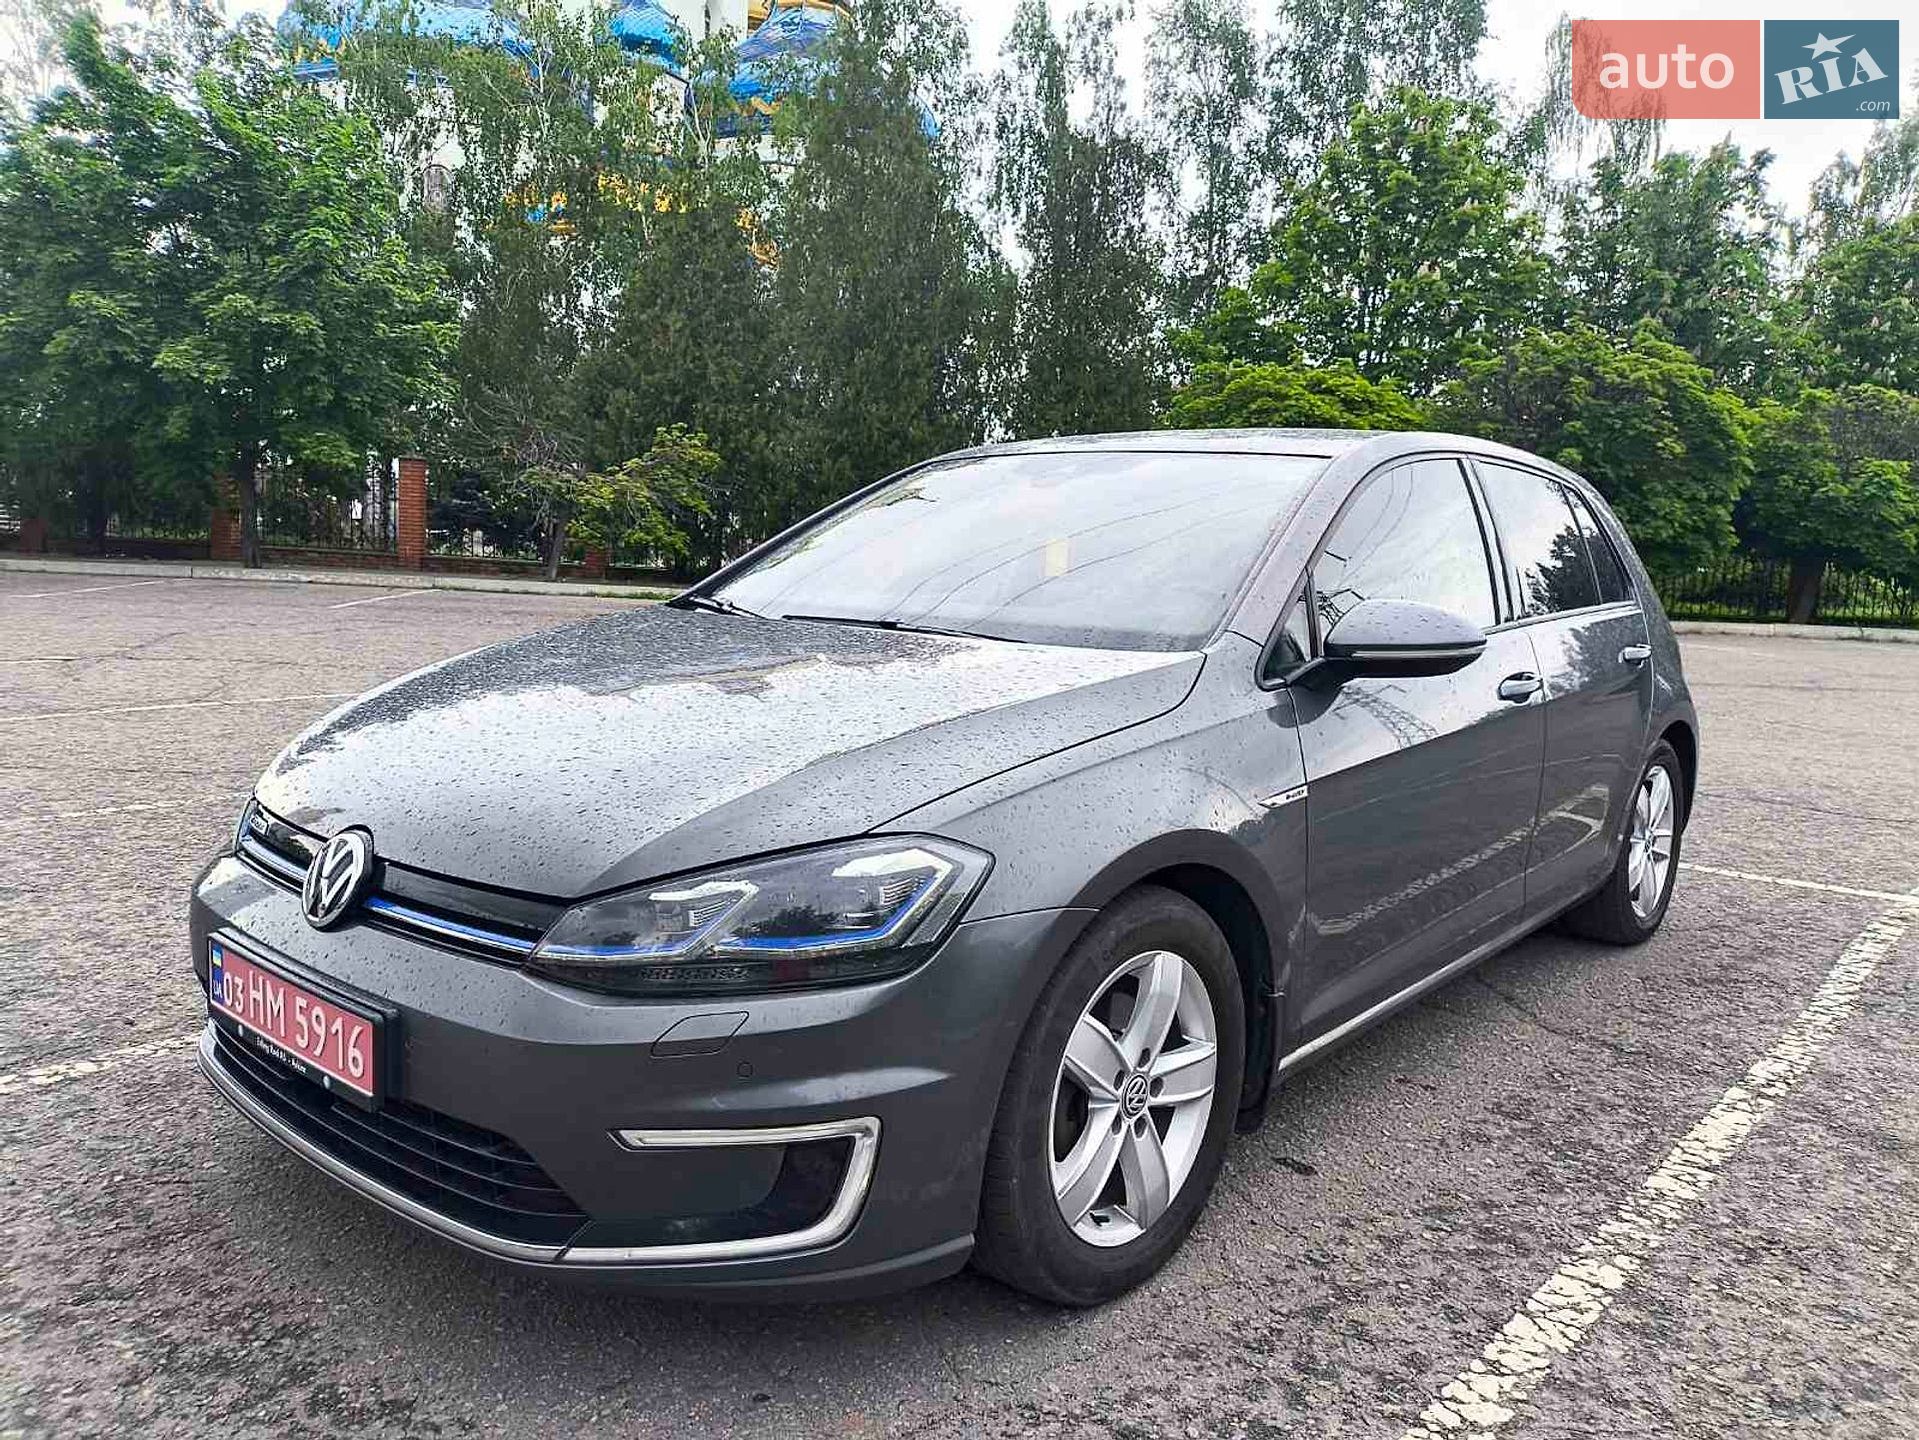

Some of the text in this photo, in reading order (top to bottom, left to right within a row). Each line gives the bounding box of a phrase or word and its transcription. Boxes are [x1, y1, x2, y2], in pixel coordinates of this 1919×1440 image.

[223, 971, 244, 1013] 03
[249, 970, 286, 1038] HM
[295, 995, 365, 1078] 5916
